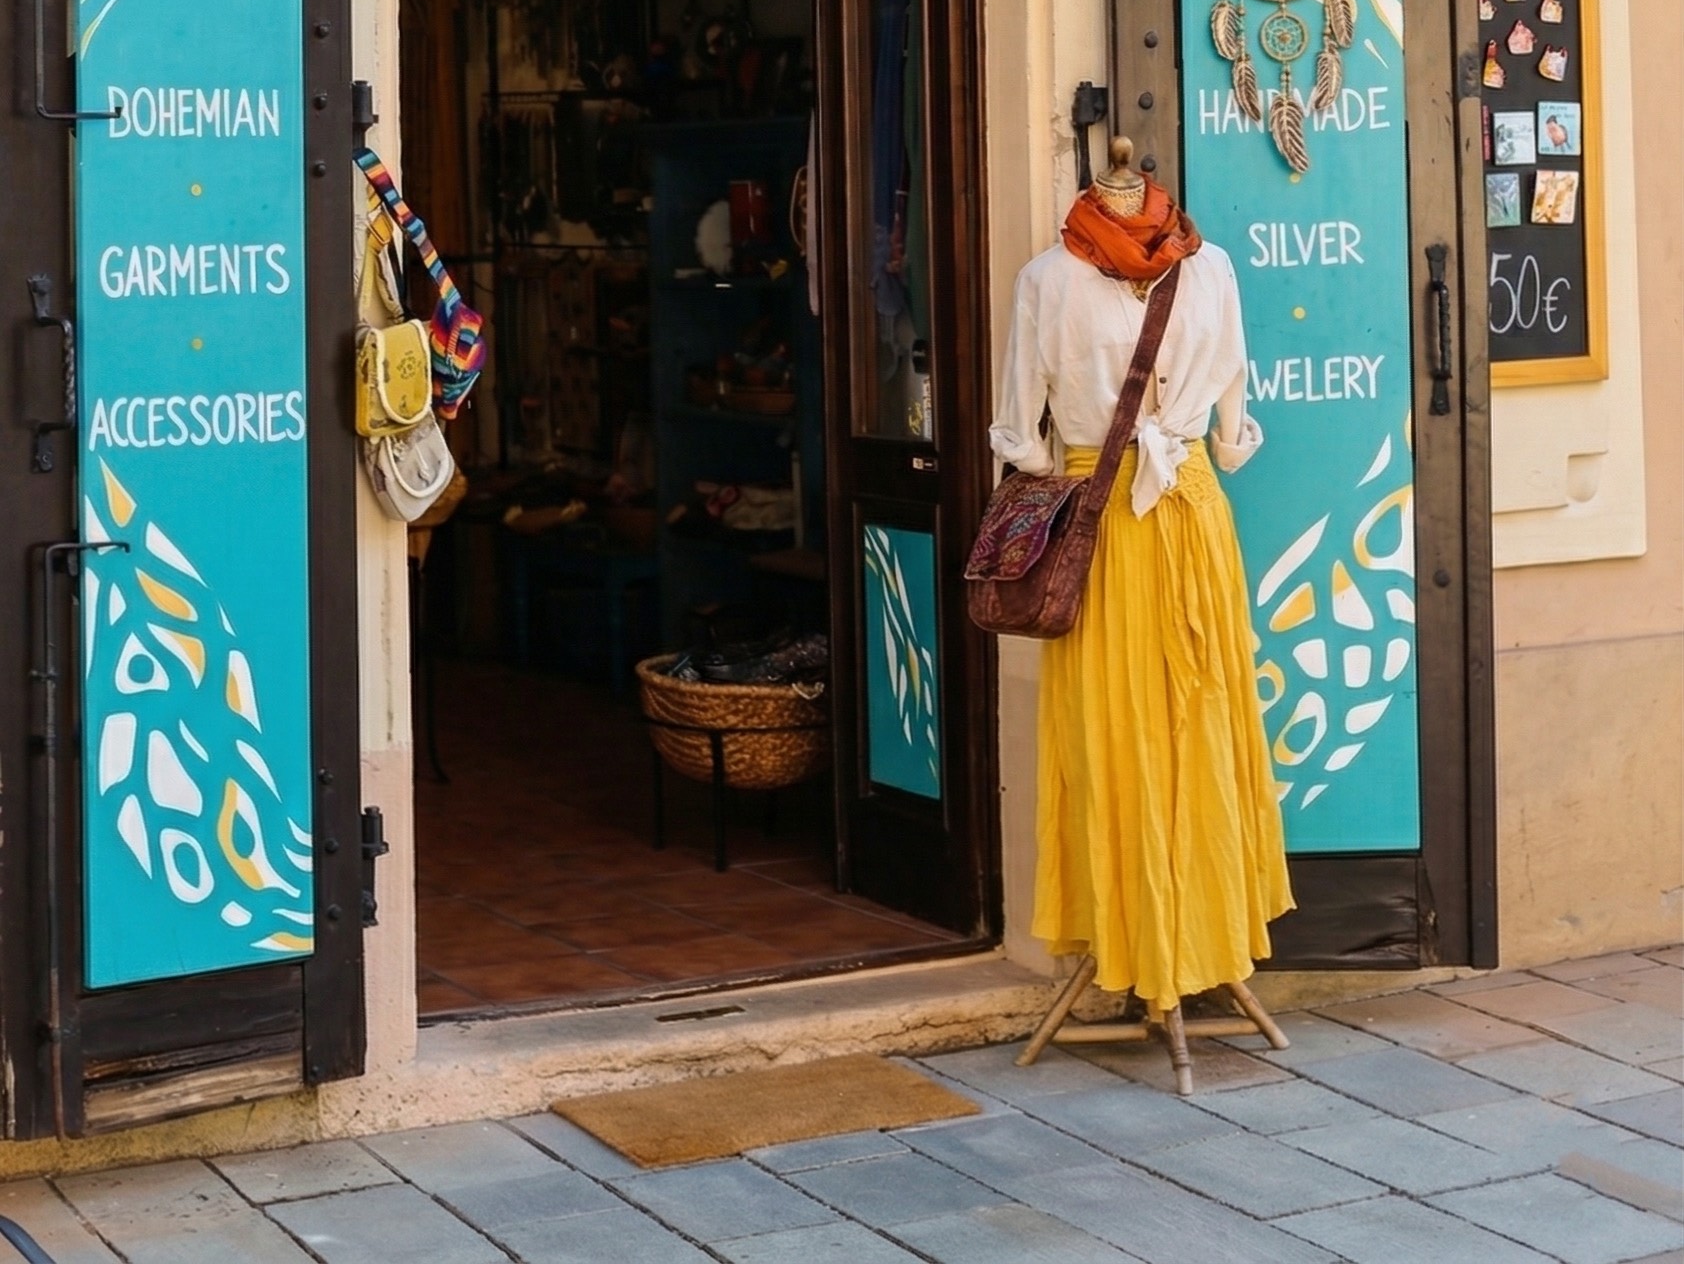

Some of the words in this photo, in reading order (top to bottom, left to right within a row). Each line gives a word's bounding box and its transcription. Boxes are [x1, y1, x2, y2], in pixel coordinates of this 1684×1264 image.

[107, 86, 280, 139] BOHEMIAN
[1248, 220, 1365, 268] SILVER
[99, 243, 290, 299] GARMENTS
[1245, 354, 1386, 403] WELERY
[88, 389, 307, 452] ACCESSORIES
